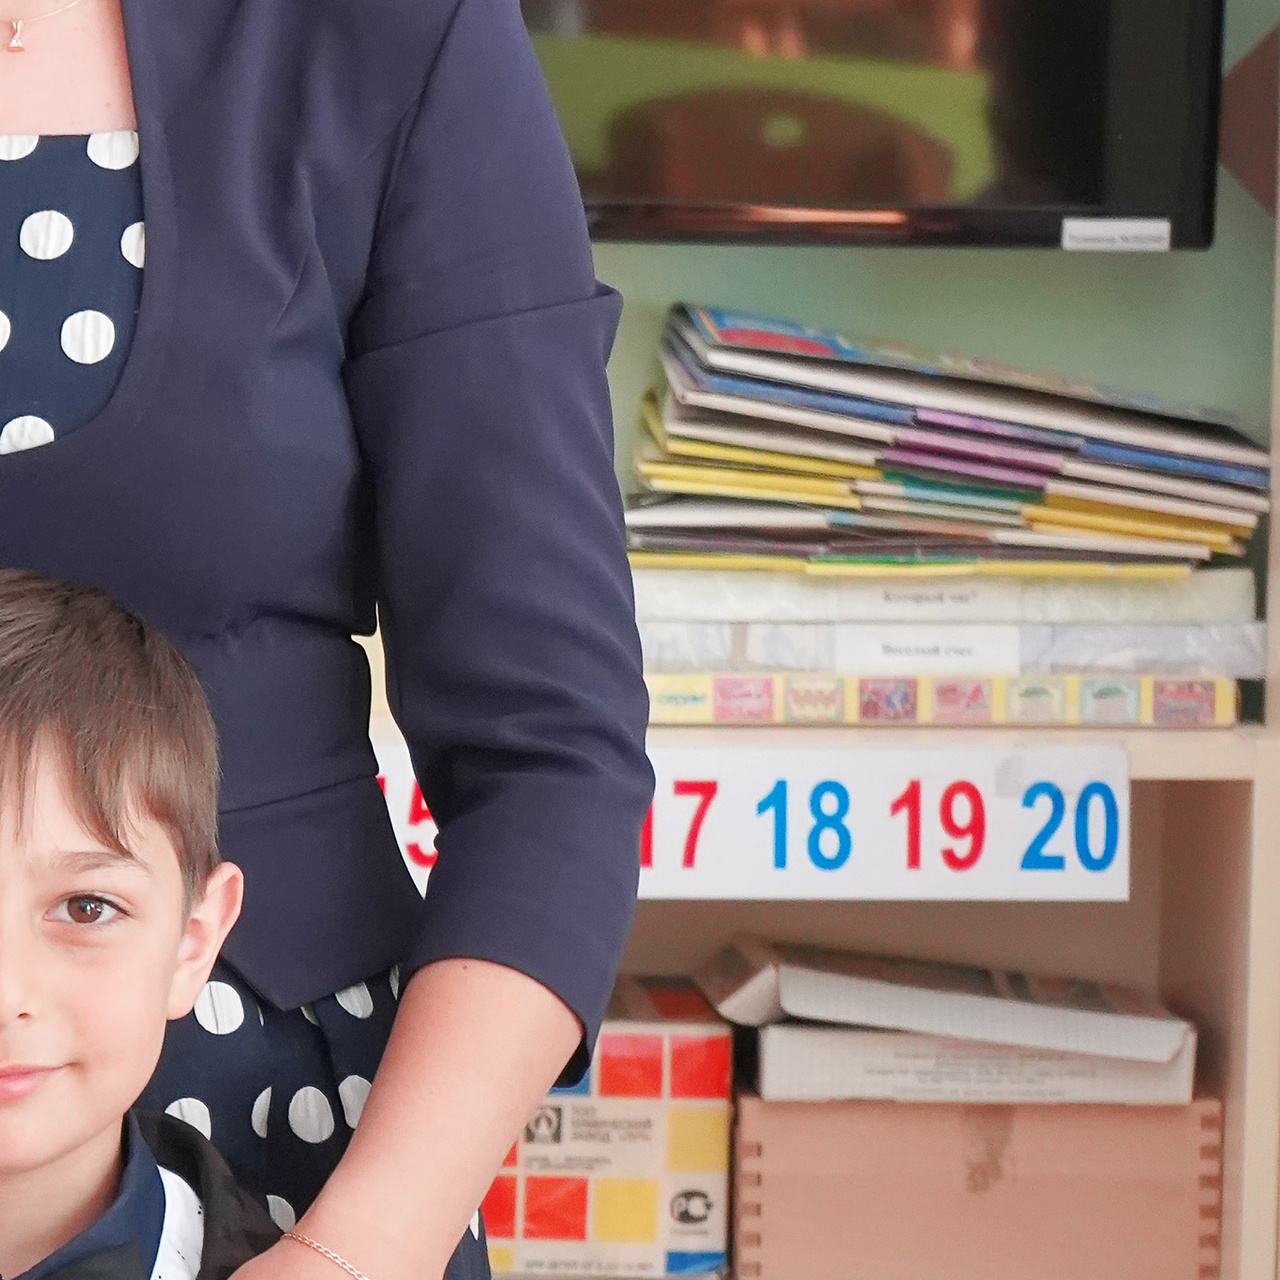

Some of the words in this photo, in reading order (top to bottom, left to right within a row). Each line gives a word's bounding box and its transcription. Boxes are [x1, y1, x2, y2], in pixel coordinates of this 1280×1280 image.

[756, 779, 853, 871] 18
[891, 780, 986, 871] 19
[1020, 781, 1120, 872] 20
